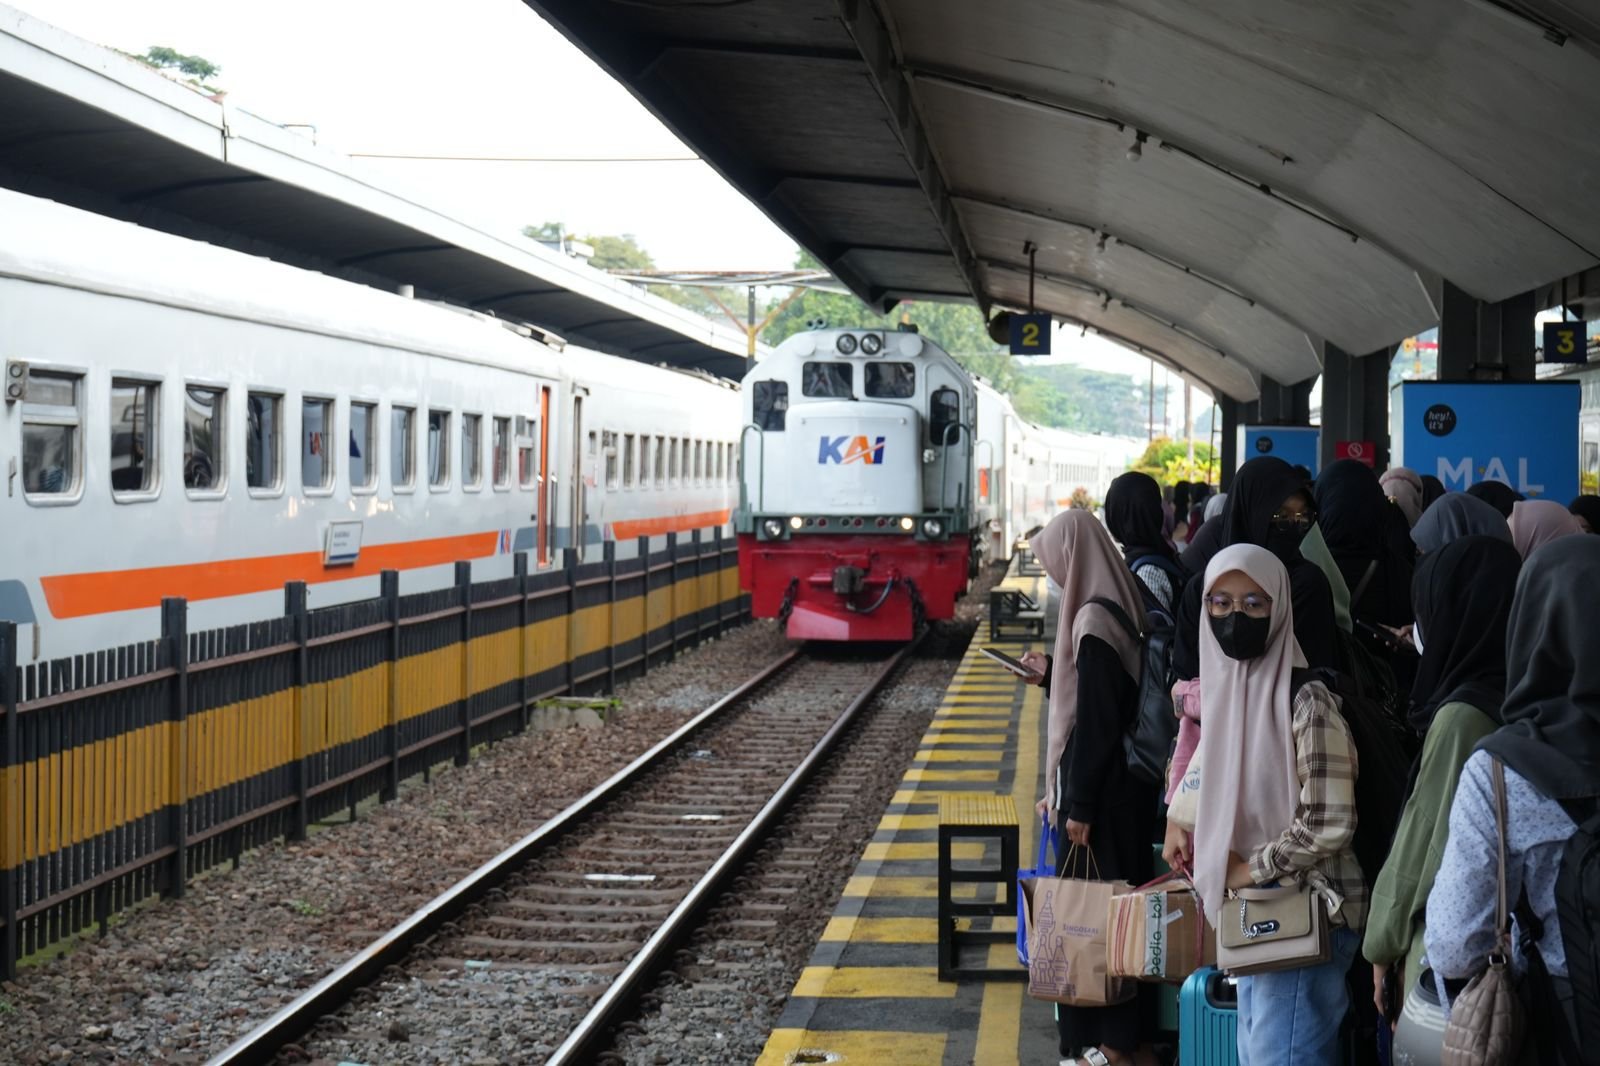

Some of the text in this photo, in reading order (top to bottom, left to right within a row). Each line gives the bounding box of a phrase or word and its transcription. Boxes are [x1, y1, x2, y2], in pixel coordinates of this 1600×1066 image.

[1022, 323, 1039, 346] 2
[1556, 330, 1575, 354] 3
[818, 435, 886, 465] KAI
[1437, 457, 1545, 493] MAL
